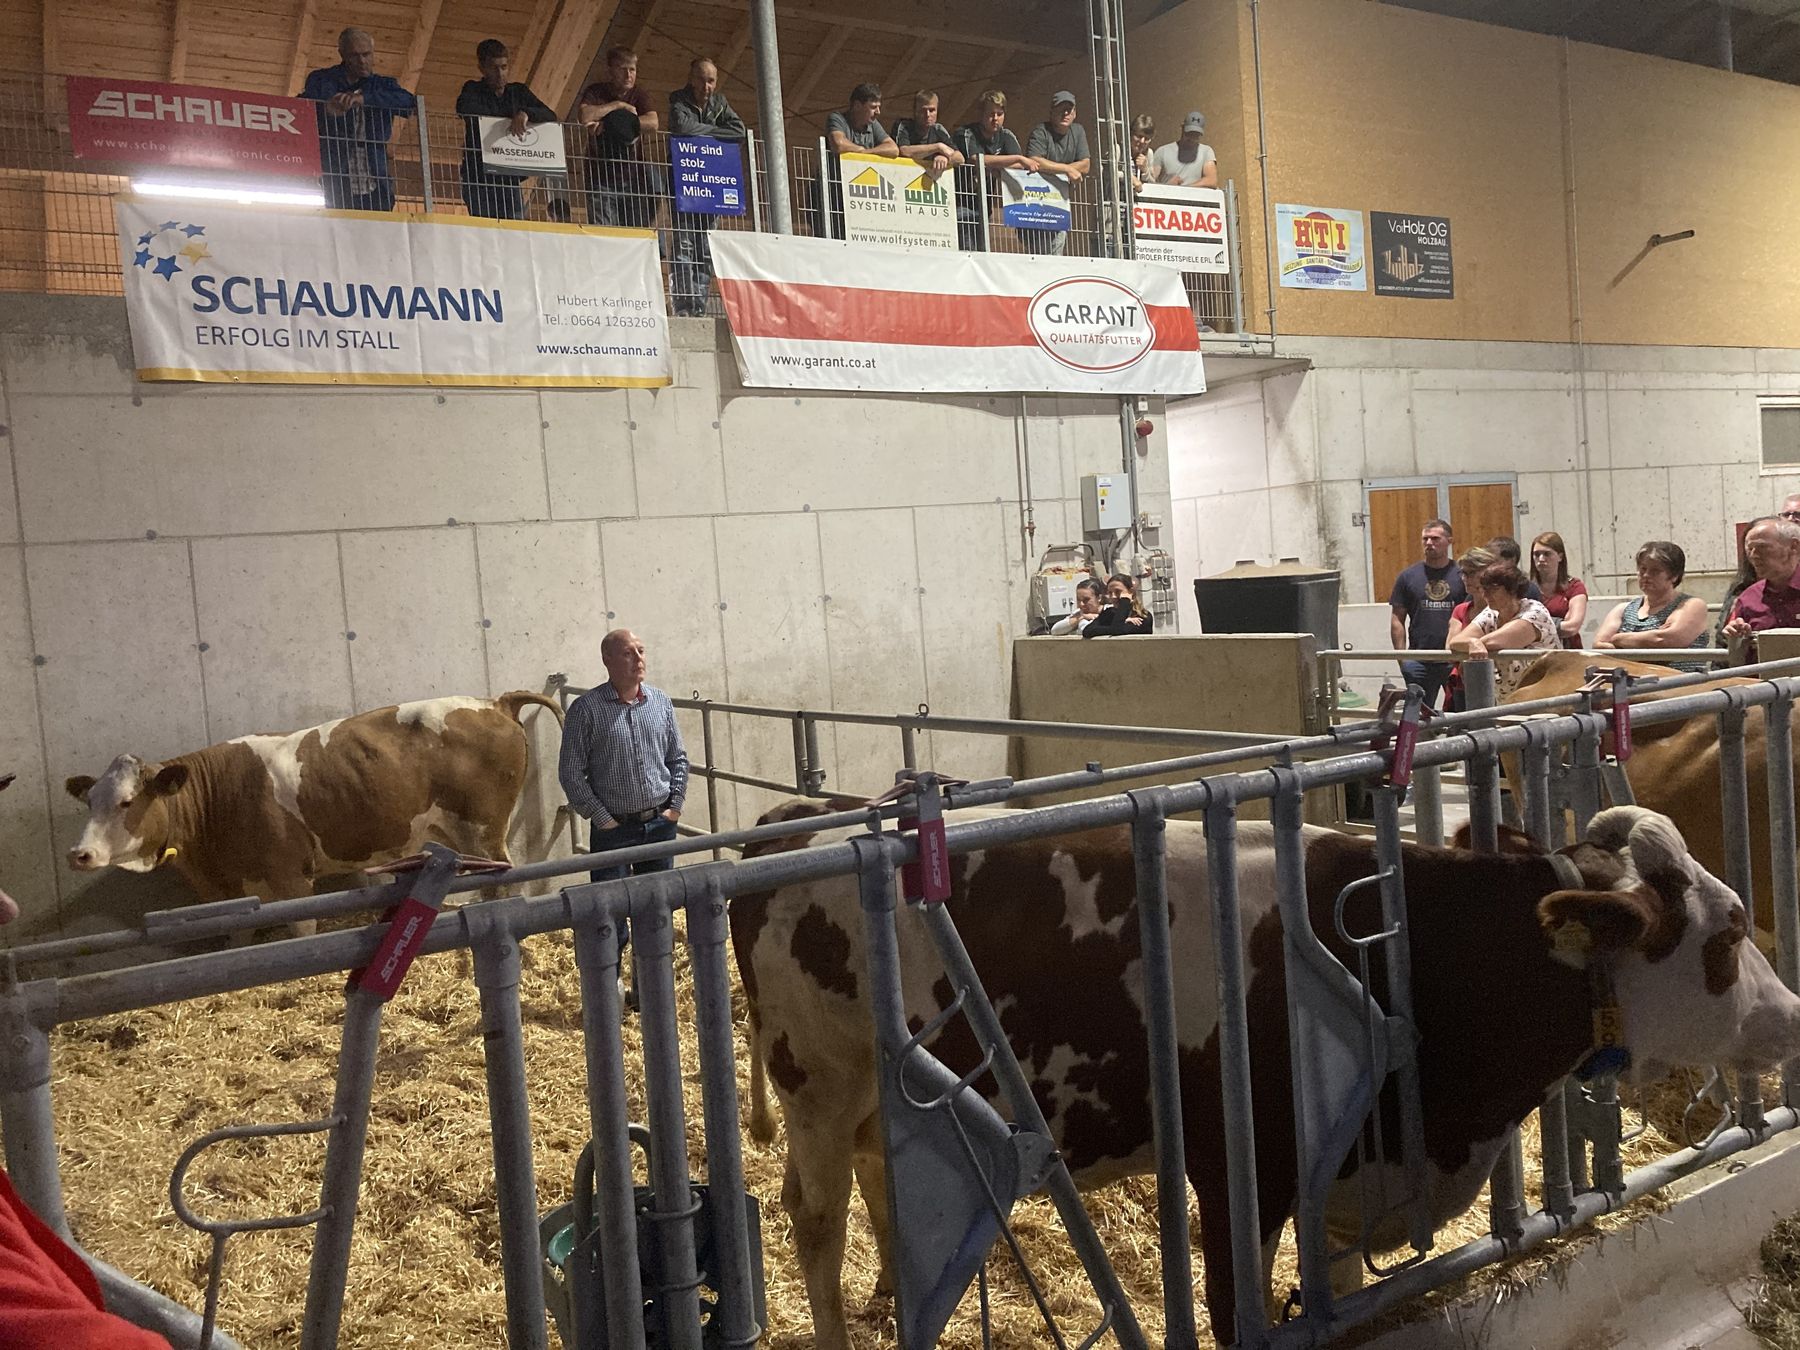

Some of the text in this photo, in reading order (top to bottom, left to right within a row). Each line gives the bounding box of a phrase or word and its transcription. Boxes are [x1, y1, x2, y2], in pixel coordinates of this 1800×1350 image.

[88, 90, 301, 134] SCHAUER
[492, 147, 556, 159] WASSERBAUER
[678, 142, 723, 155] Wir sind
[680, 158, 705, 168] stolz
[682, 172, 737, 185] auf unsere
[683, 186, 715, 198] Milch.
[850, 201, 896, 213] SYSTEM
[1133, 207, 1222, 233] STRABAG
[1294, 220, 1346, 250] HTI
[1428, 222, 1447, 237] OG
[851, 233, 951, 248] www.wolfsystem.at
[1136, 253, 1163, 262] TIROLER
[1163, 254, 1199, 263] FESTSPIELE
[191, 275, 503, 323] SCHAUMANN
[557, 295, 652, 310] Hubert Karlinger
[544, 314, 656, 328] Tel.: 0664 1263260
[1045, 303, 1137, 327] GARANT
[196, 325, 400, 349] ERFOLG IM STALL
[1050, 332, 1142, 345] QUALITÄTSFUTTER
[537, 344, 658, 356] www.schaumann.at
[771, 355, 876, 369] www.garant.co.at
[380, 915, 424, 983] SCHAUER
